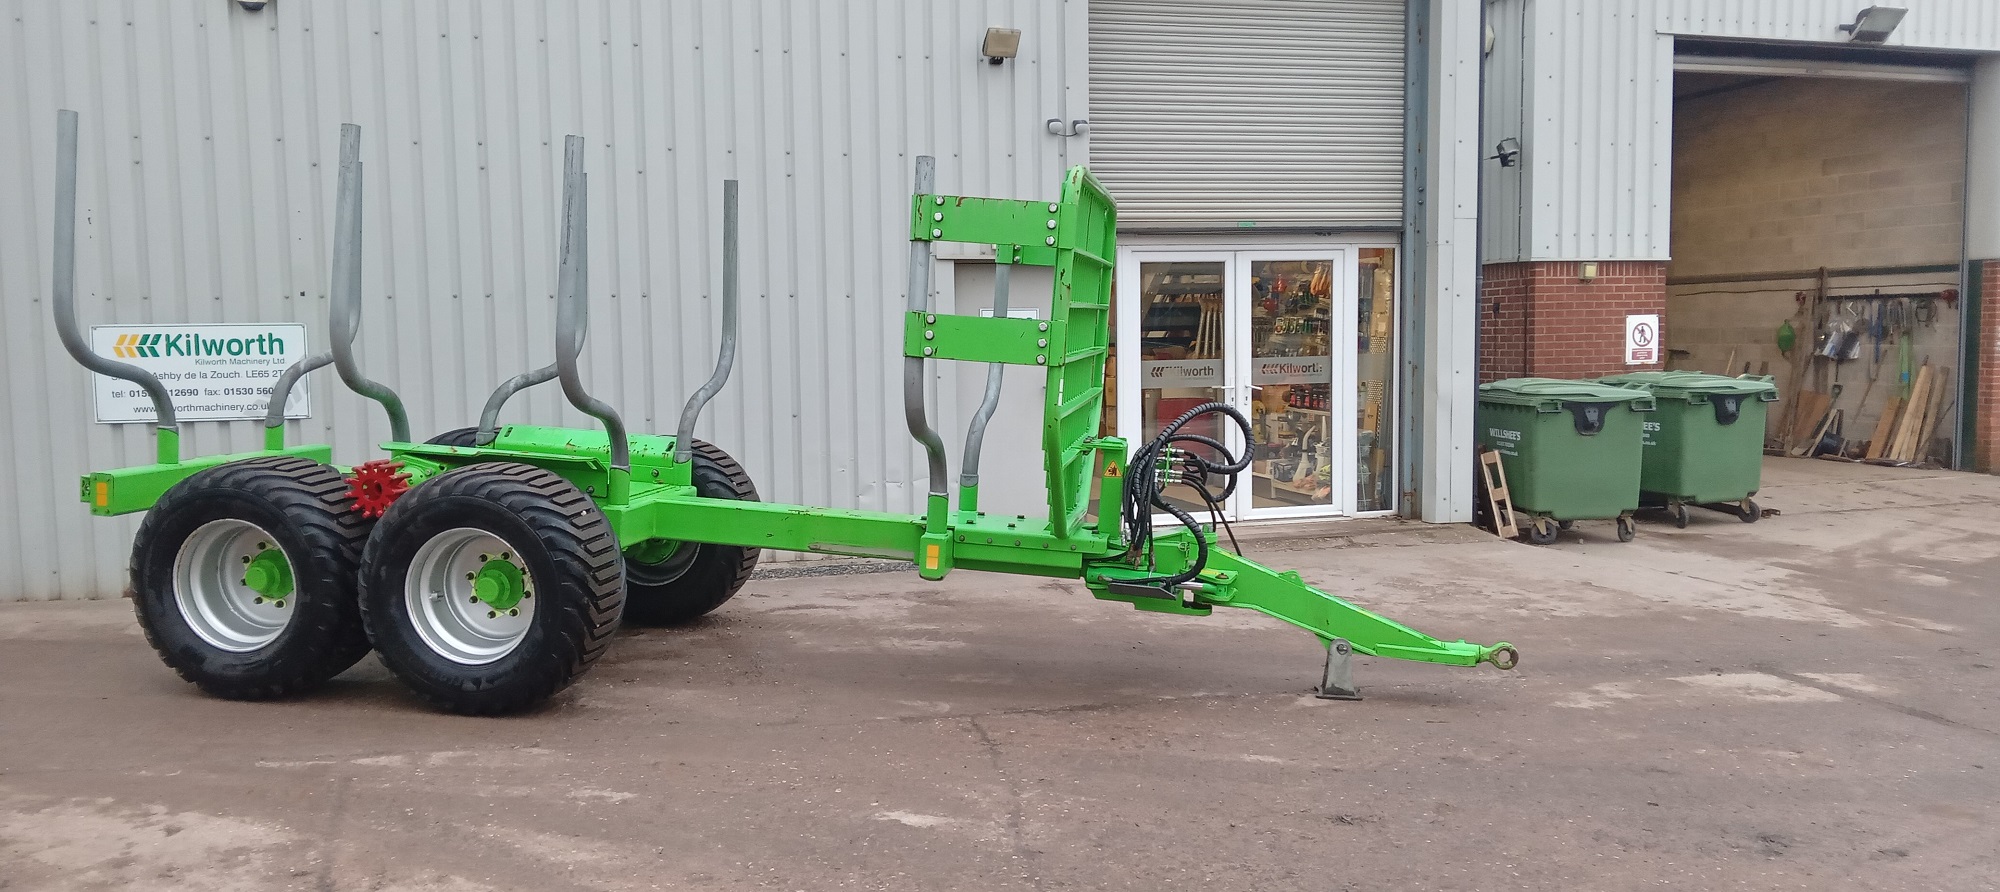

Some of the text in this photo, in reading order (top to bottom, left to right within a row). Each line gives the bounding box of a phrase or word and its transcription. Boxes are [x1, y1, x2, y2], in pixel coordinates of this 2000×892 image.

[165, 333, 285, 358] Kilworth
[195, 358, 227, 366] Kilworth
[229, 358, 271, 366] Machinery
[184, 372, 197, 380] de
[200, 371, 208, 379] la
[246, 370, 270, 378] LE65
[272, 369, 284, 378] 2T
[112, 390, 126, 398] tel:
[204, 387, 221, 396] fax:
[223, 387, 254, 396] 01530
